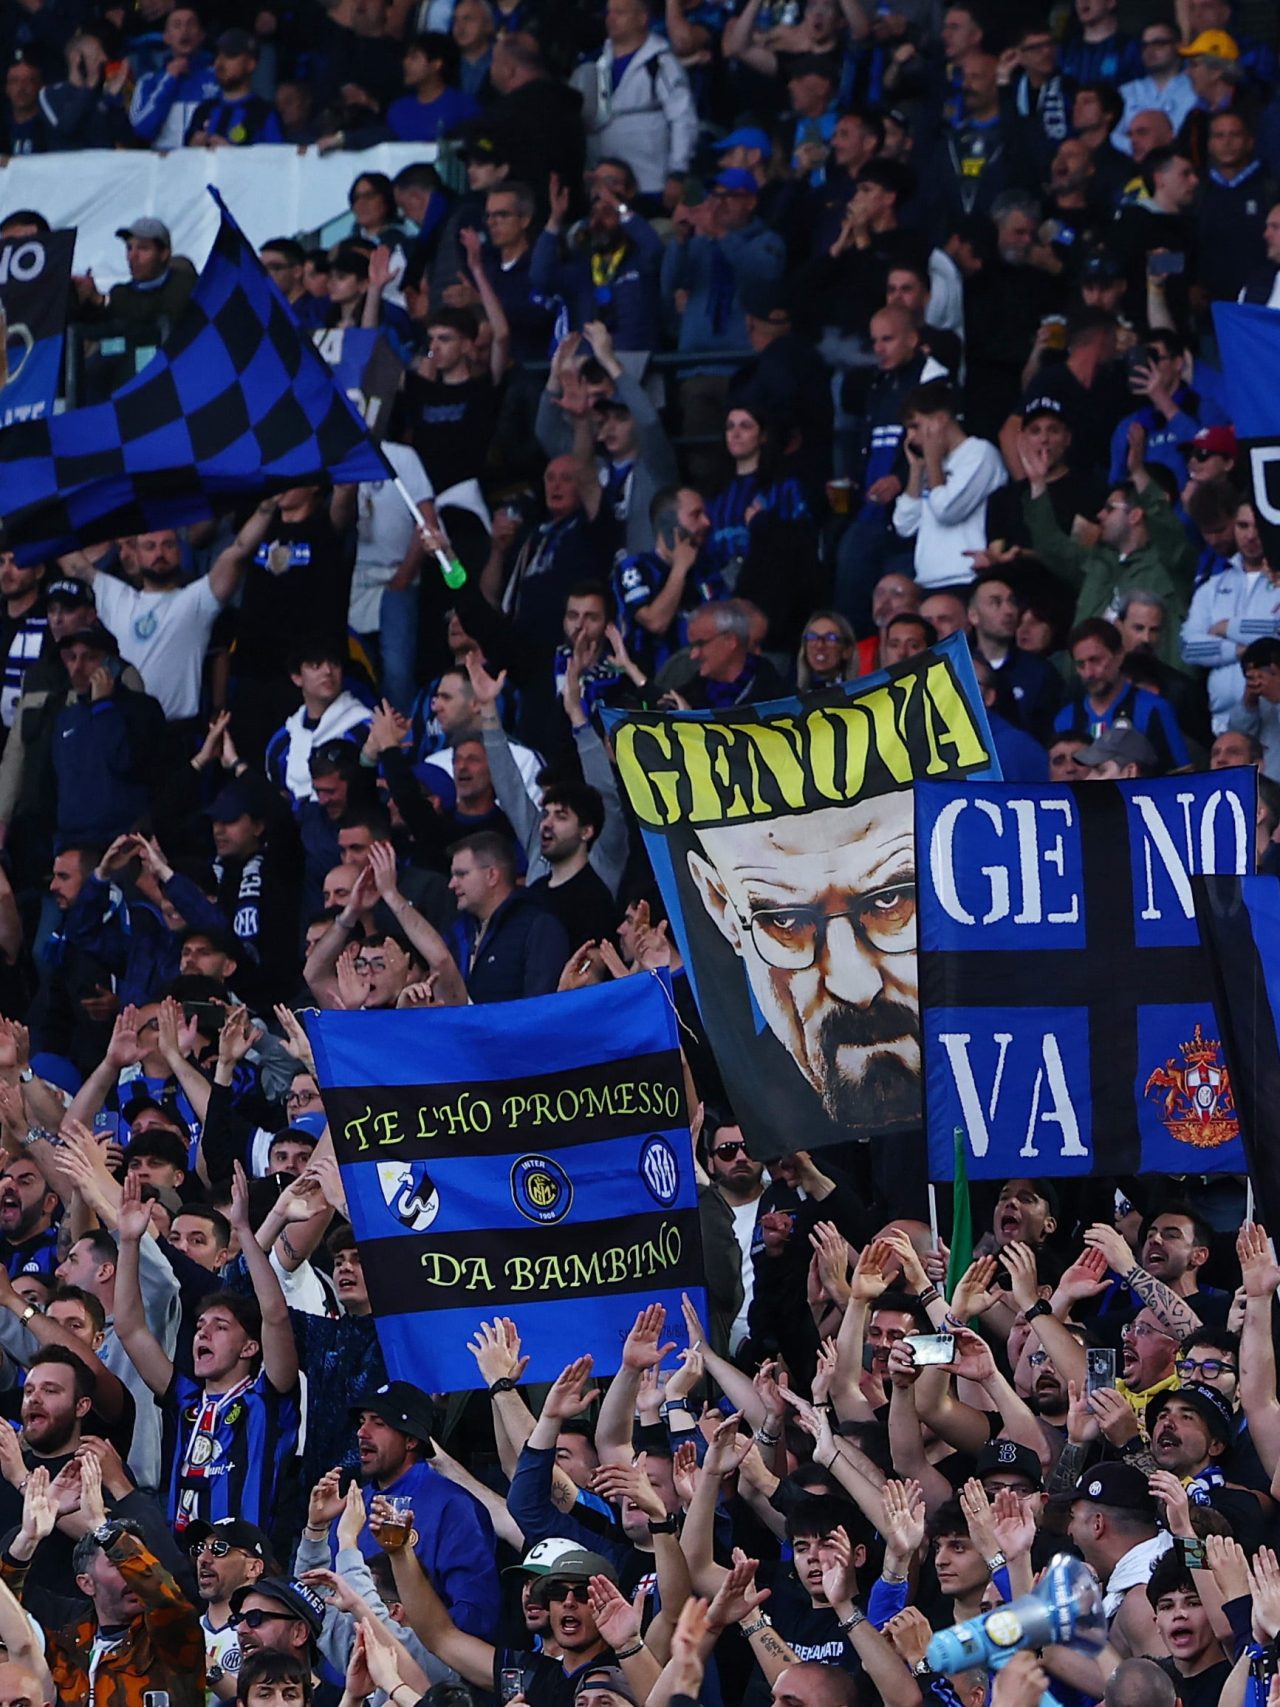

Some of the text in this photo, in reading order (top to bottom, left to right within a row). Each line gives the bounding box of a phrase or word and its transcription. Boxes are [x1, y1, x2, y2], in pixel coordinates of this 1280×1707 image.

[615, 661, 989, 826] GENOVA
[929, 789, 1248, 926] GE NO
[344, 1081, 680, 1152] TE L'HO PROMESSO
[938, 1032, 1089, 1158] VA
[520, 1159, 546, 1171] INTER
[420, 1220, 682, 1292] DA BAMBINO
